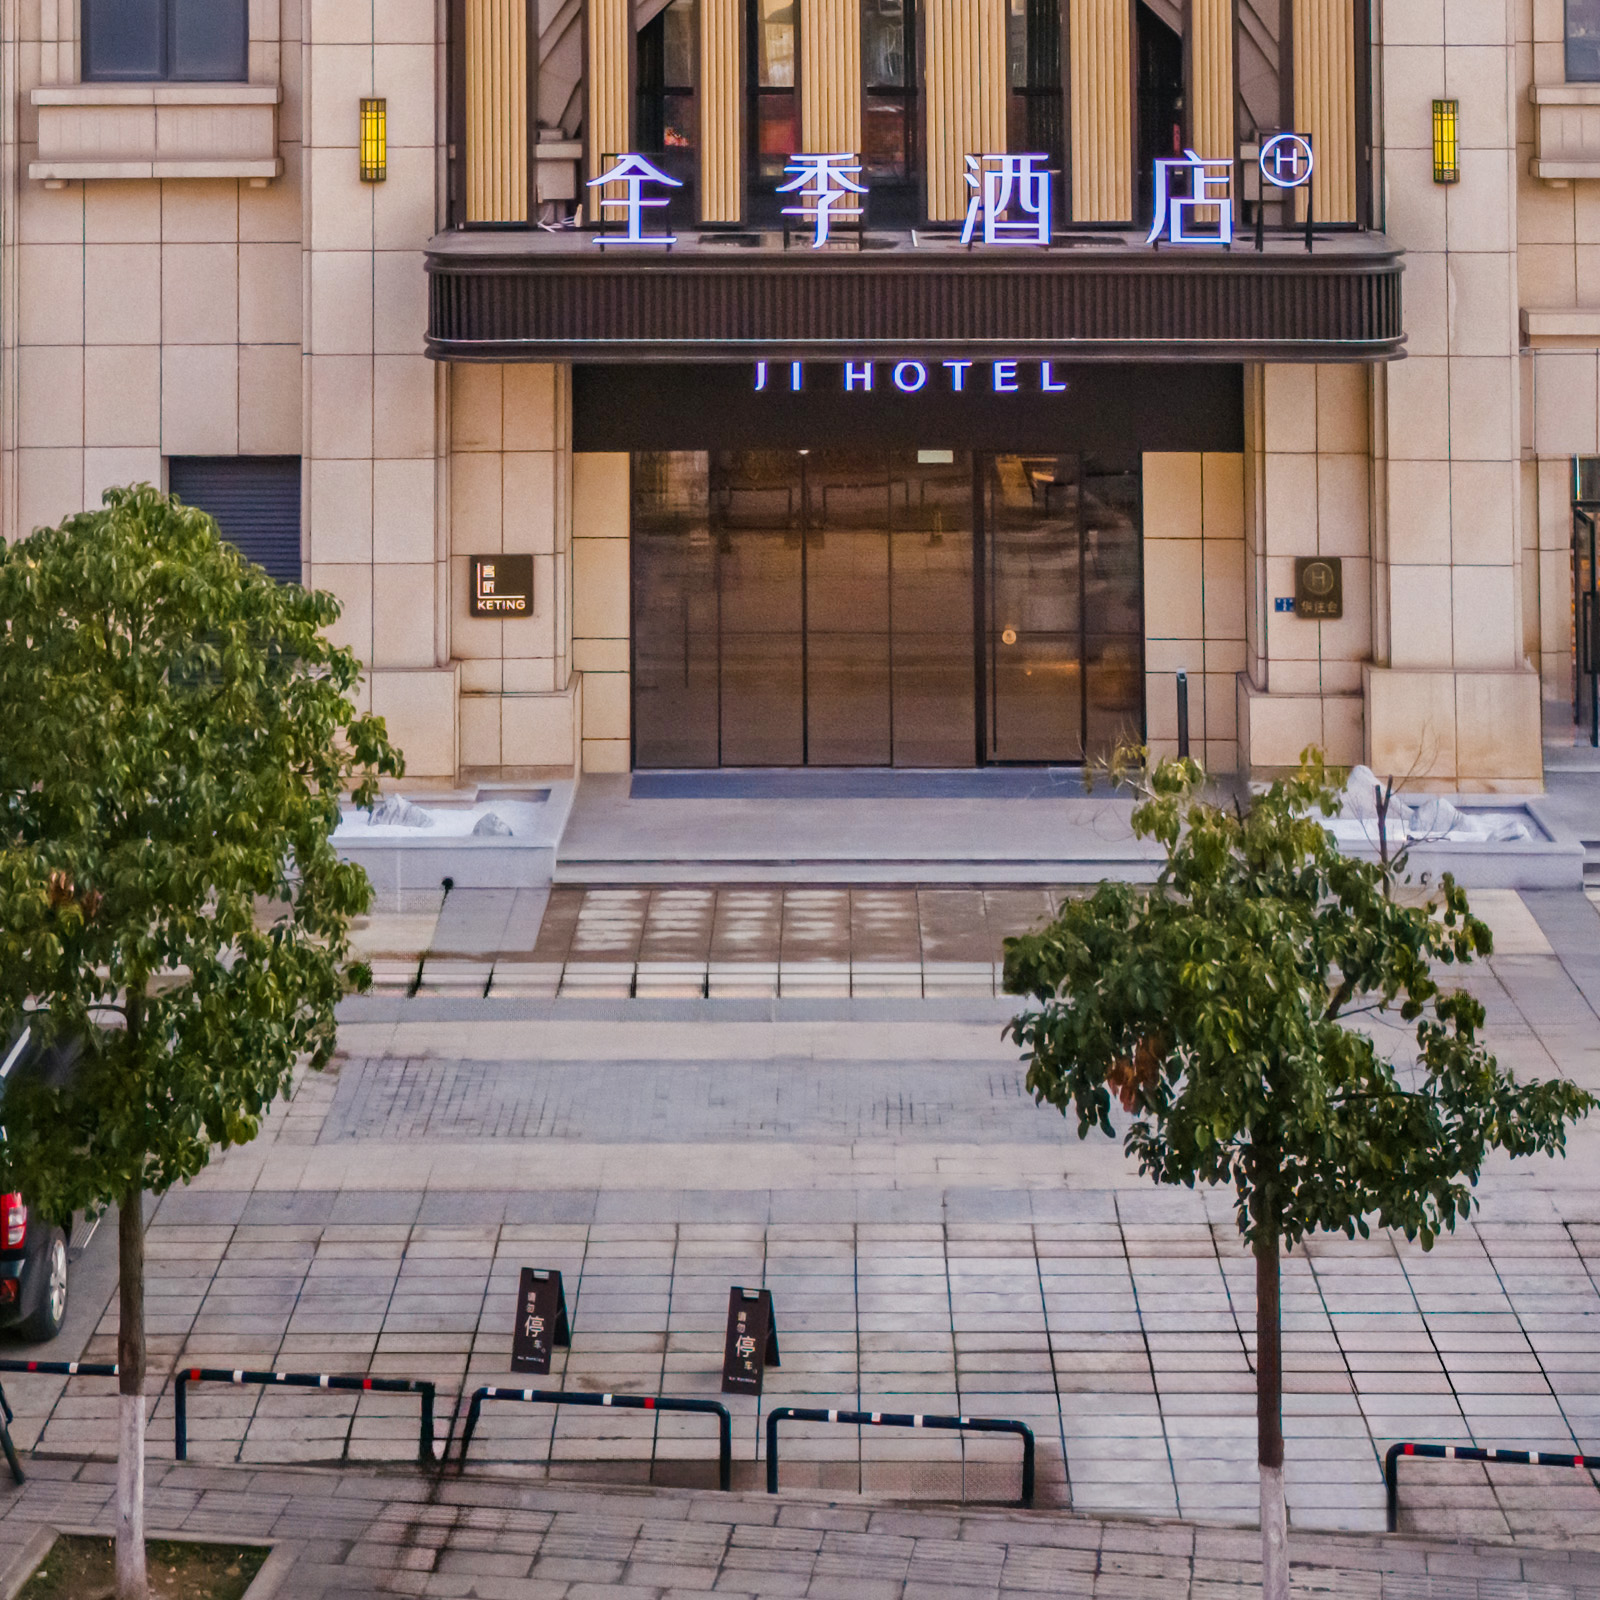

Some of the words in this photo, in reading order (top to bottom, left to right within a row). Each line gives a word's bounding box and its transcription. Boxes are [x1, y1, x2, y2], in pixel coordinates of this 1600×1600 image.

[586, 149, 1234, 249] 全季酒店
[754, 361, 802, 392] JI
[843, 361, 1067, 392] HOTEL
[477, 600, 526, 610] KETING
